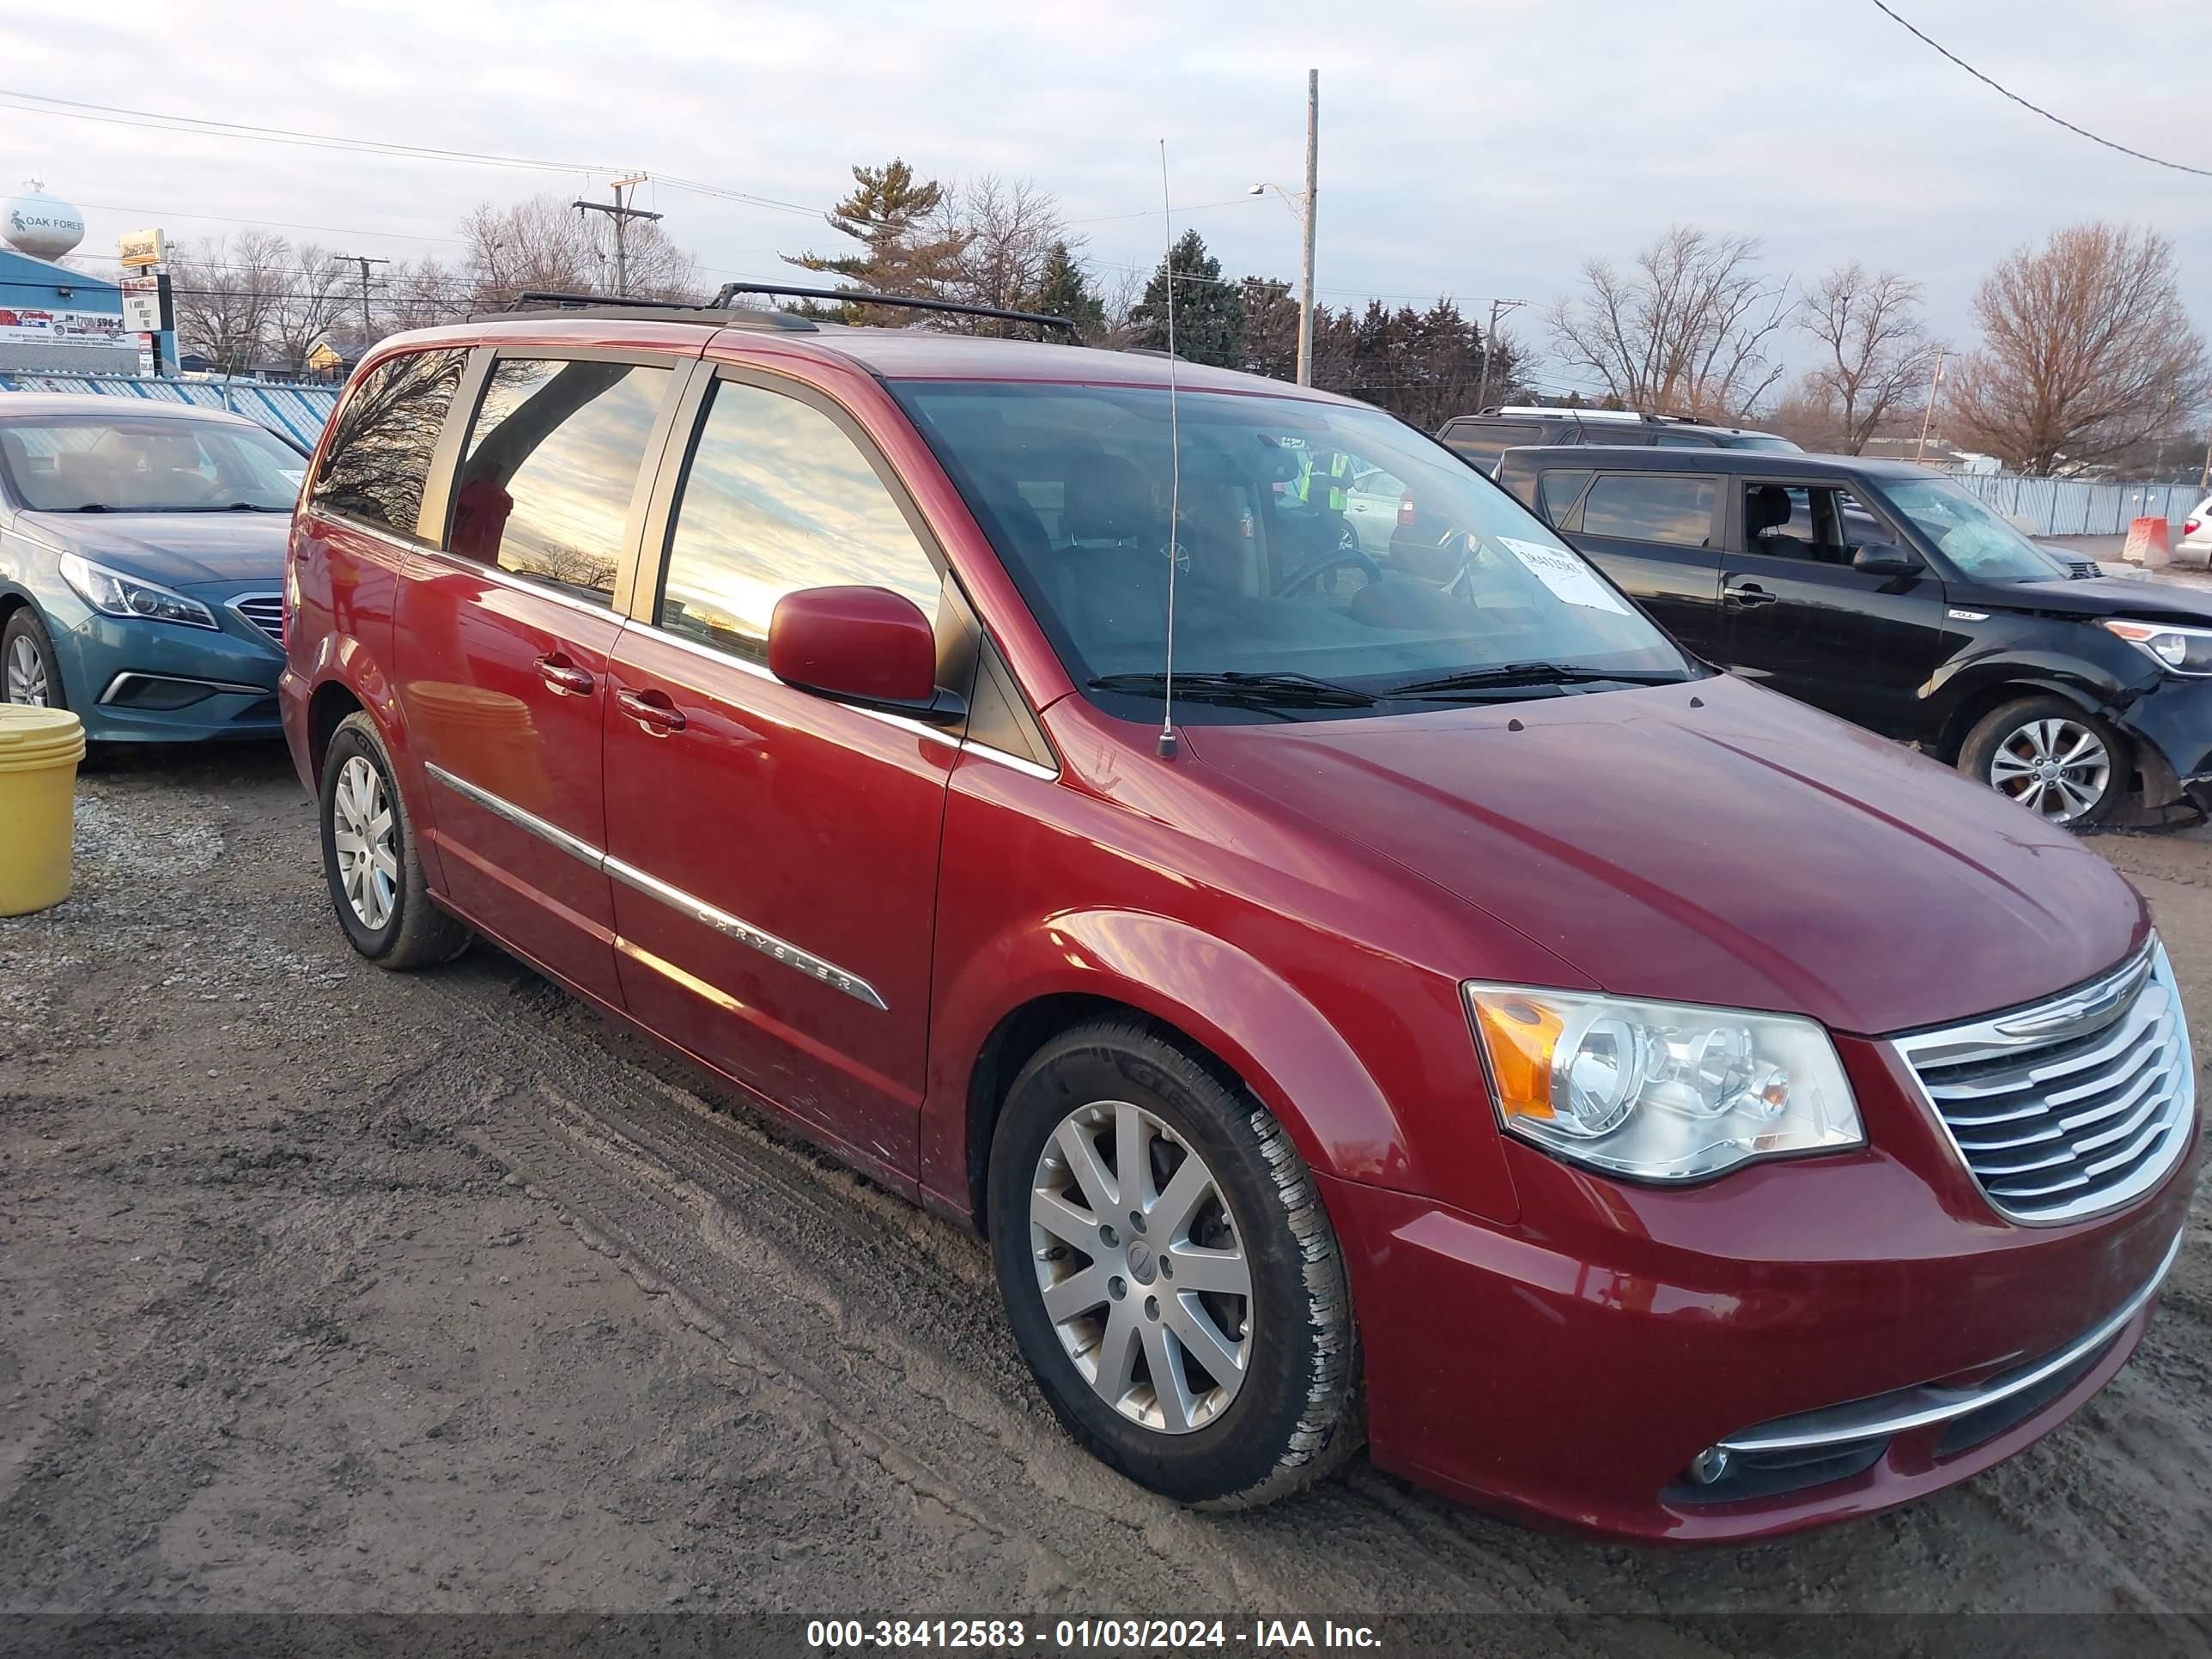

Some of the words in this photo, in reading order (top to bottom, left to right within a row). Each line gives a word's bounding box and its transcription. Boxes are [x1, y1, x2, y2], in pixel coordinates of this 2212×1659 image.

[26, 216, 51, 227] OAK
[53, 219, 82, 230] FOREST
[697, 910, 852, 990] CHRYSLER
